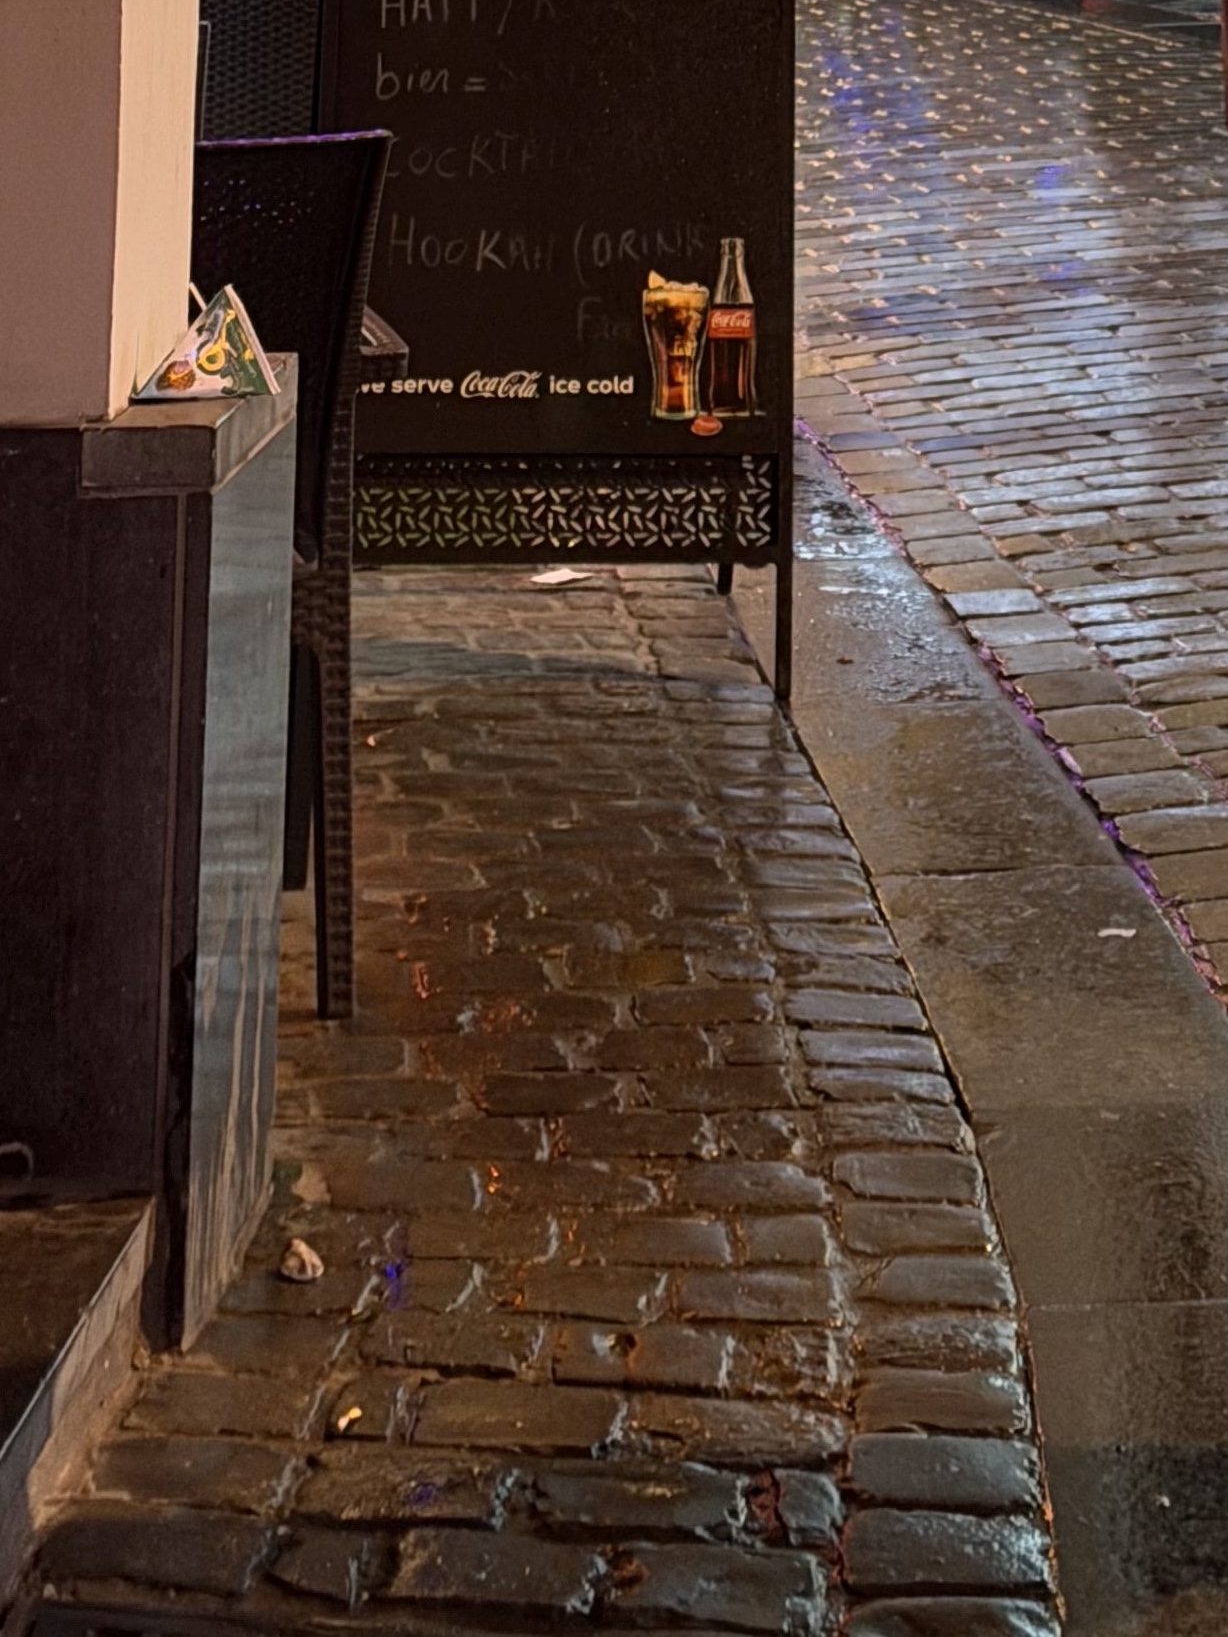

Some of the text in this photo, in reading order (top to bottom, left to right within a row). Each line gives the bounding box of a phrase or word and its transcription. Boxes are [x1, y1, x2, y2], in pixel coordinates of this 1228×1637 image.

[391, 375, 453, 394] serve
[460, 370, 542, 398] Coca-Cola
[550, 375, 580, 394] ice
[587, 375, 634, 394] cold
